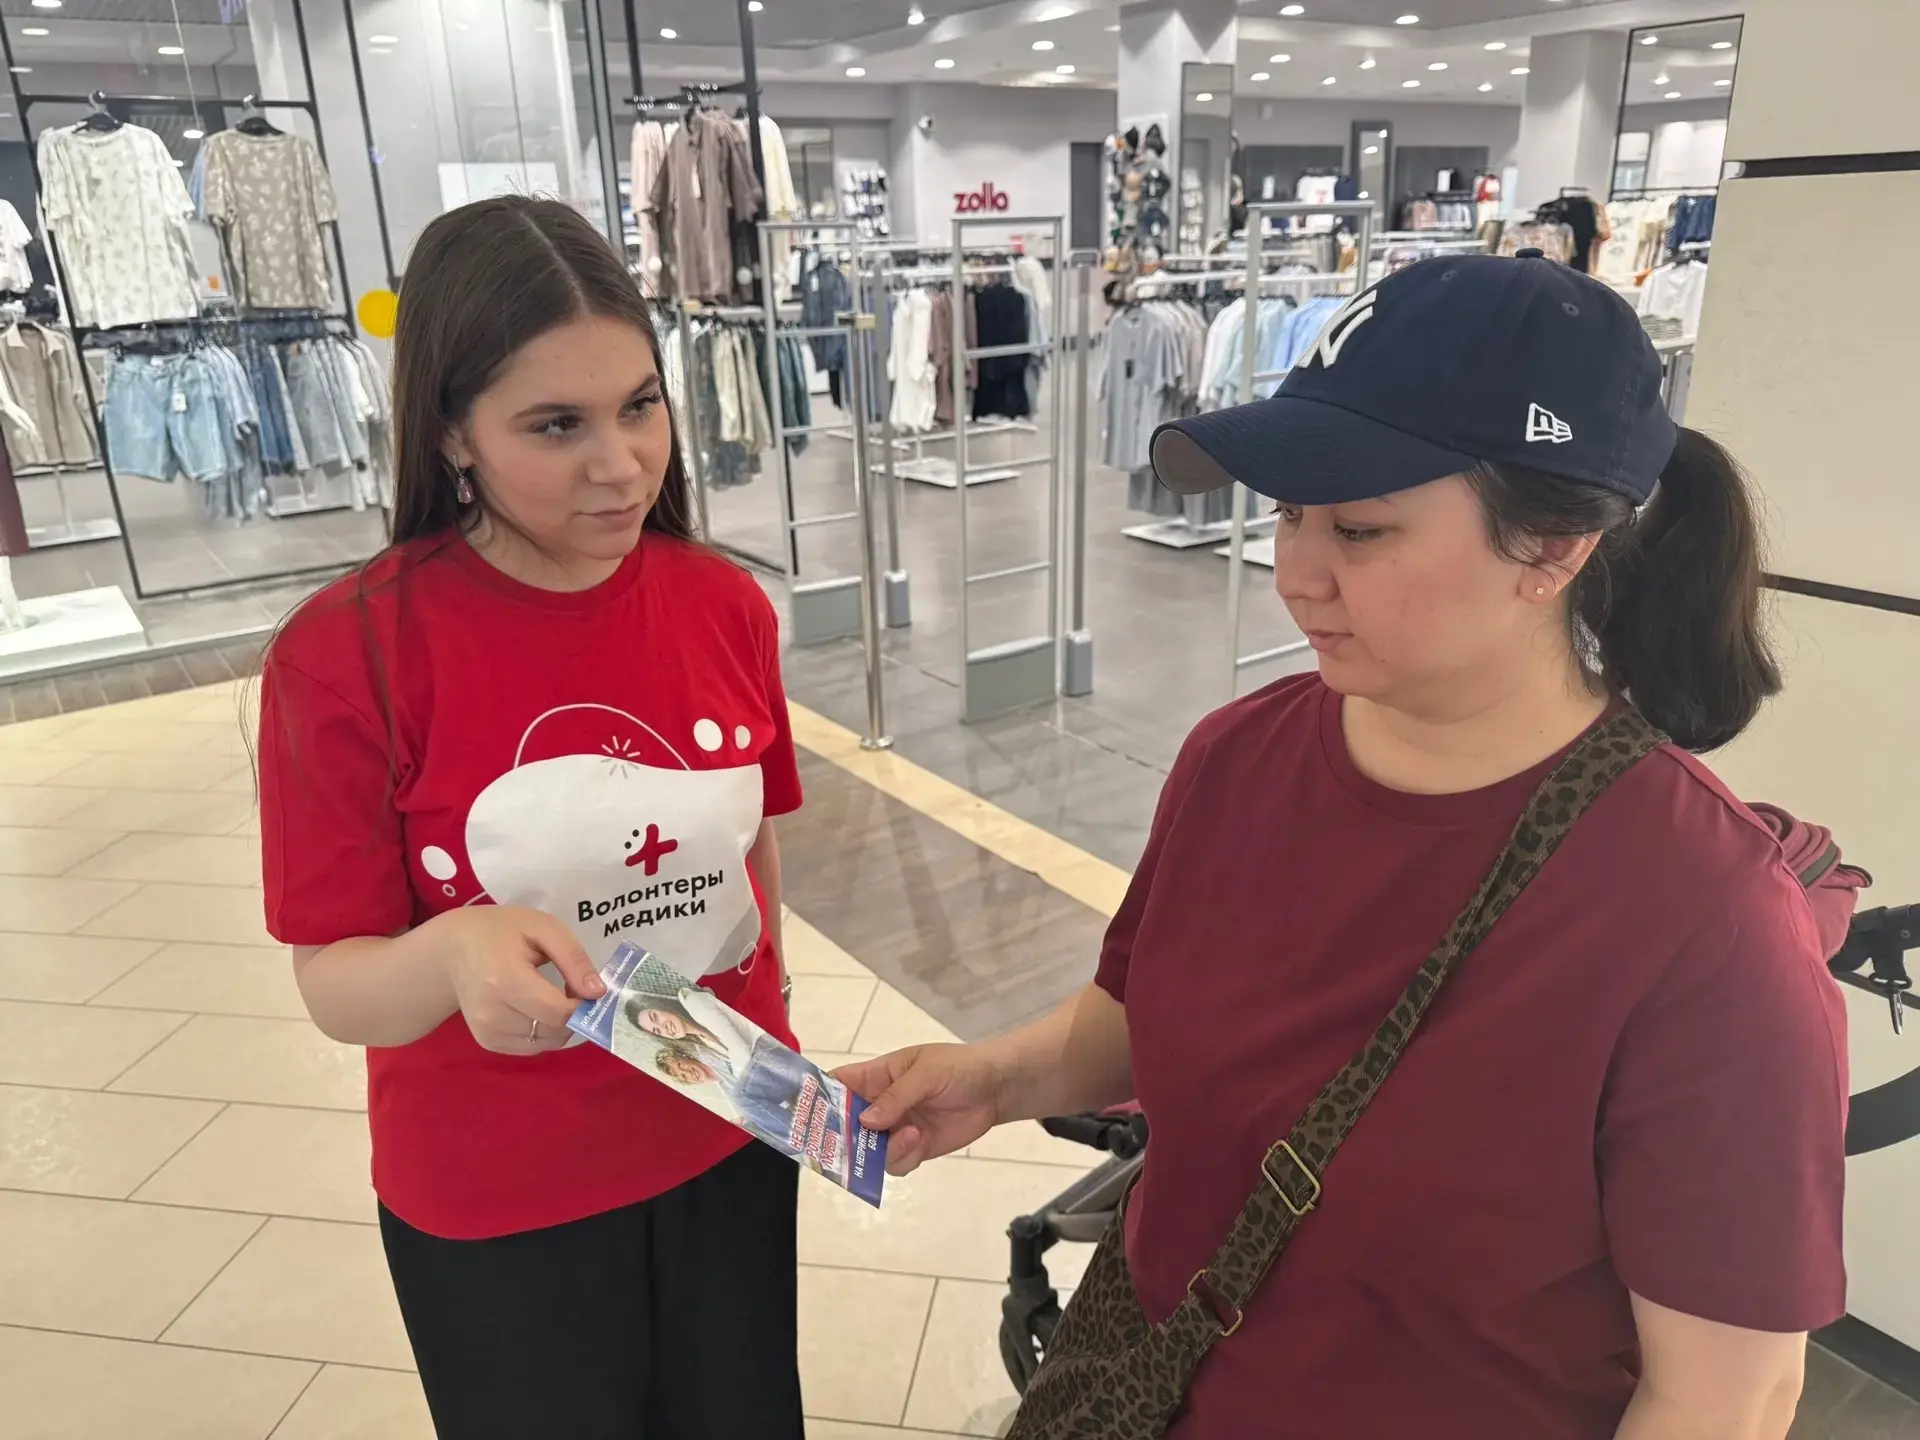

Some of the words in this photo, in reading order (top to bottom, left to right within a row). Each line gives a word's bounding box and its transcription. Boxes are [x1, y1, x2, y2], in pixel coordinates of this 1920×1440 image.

[577, 869, 724, 923] Волонтеры
[603, 898, 706, 938] медики
[790, 1131, 804, 1152] НЕ
[805, 1097, 828, 1160] РОМАНТИКУ
[855, 1124, 868, 1167] НЕПРИЯТНО
[867, 1129, 878, 1151] БОЛЕ
[821, 1129, 838, 1170] ЛЮБВИ
[853, 1165, 864, 1179] НА
